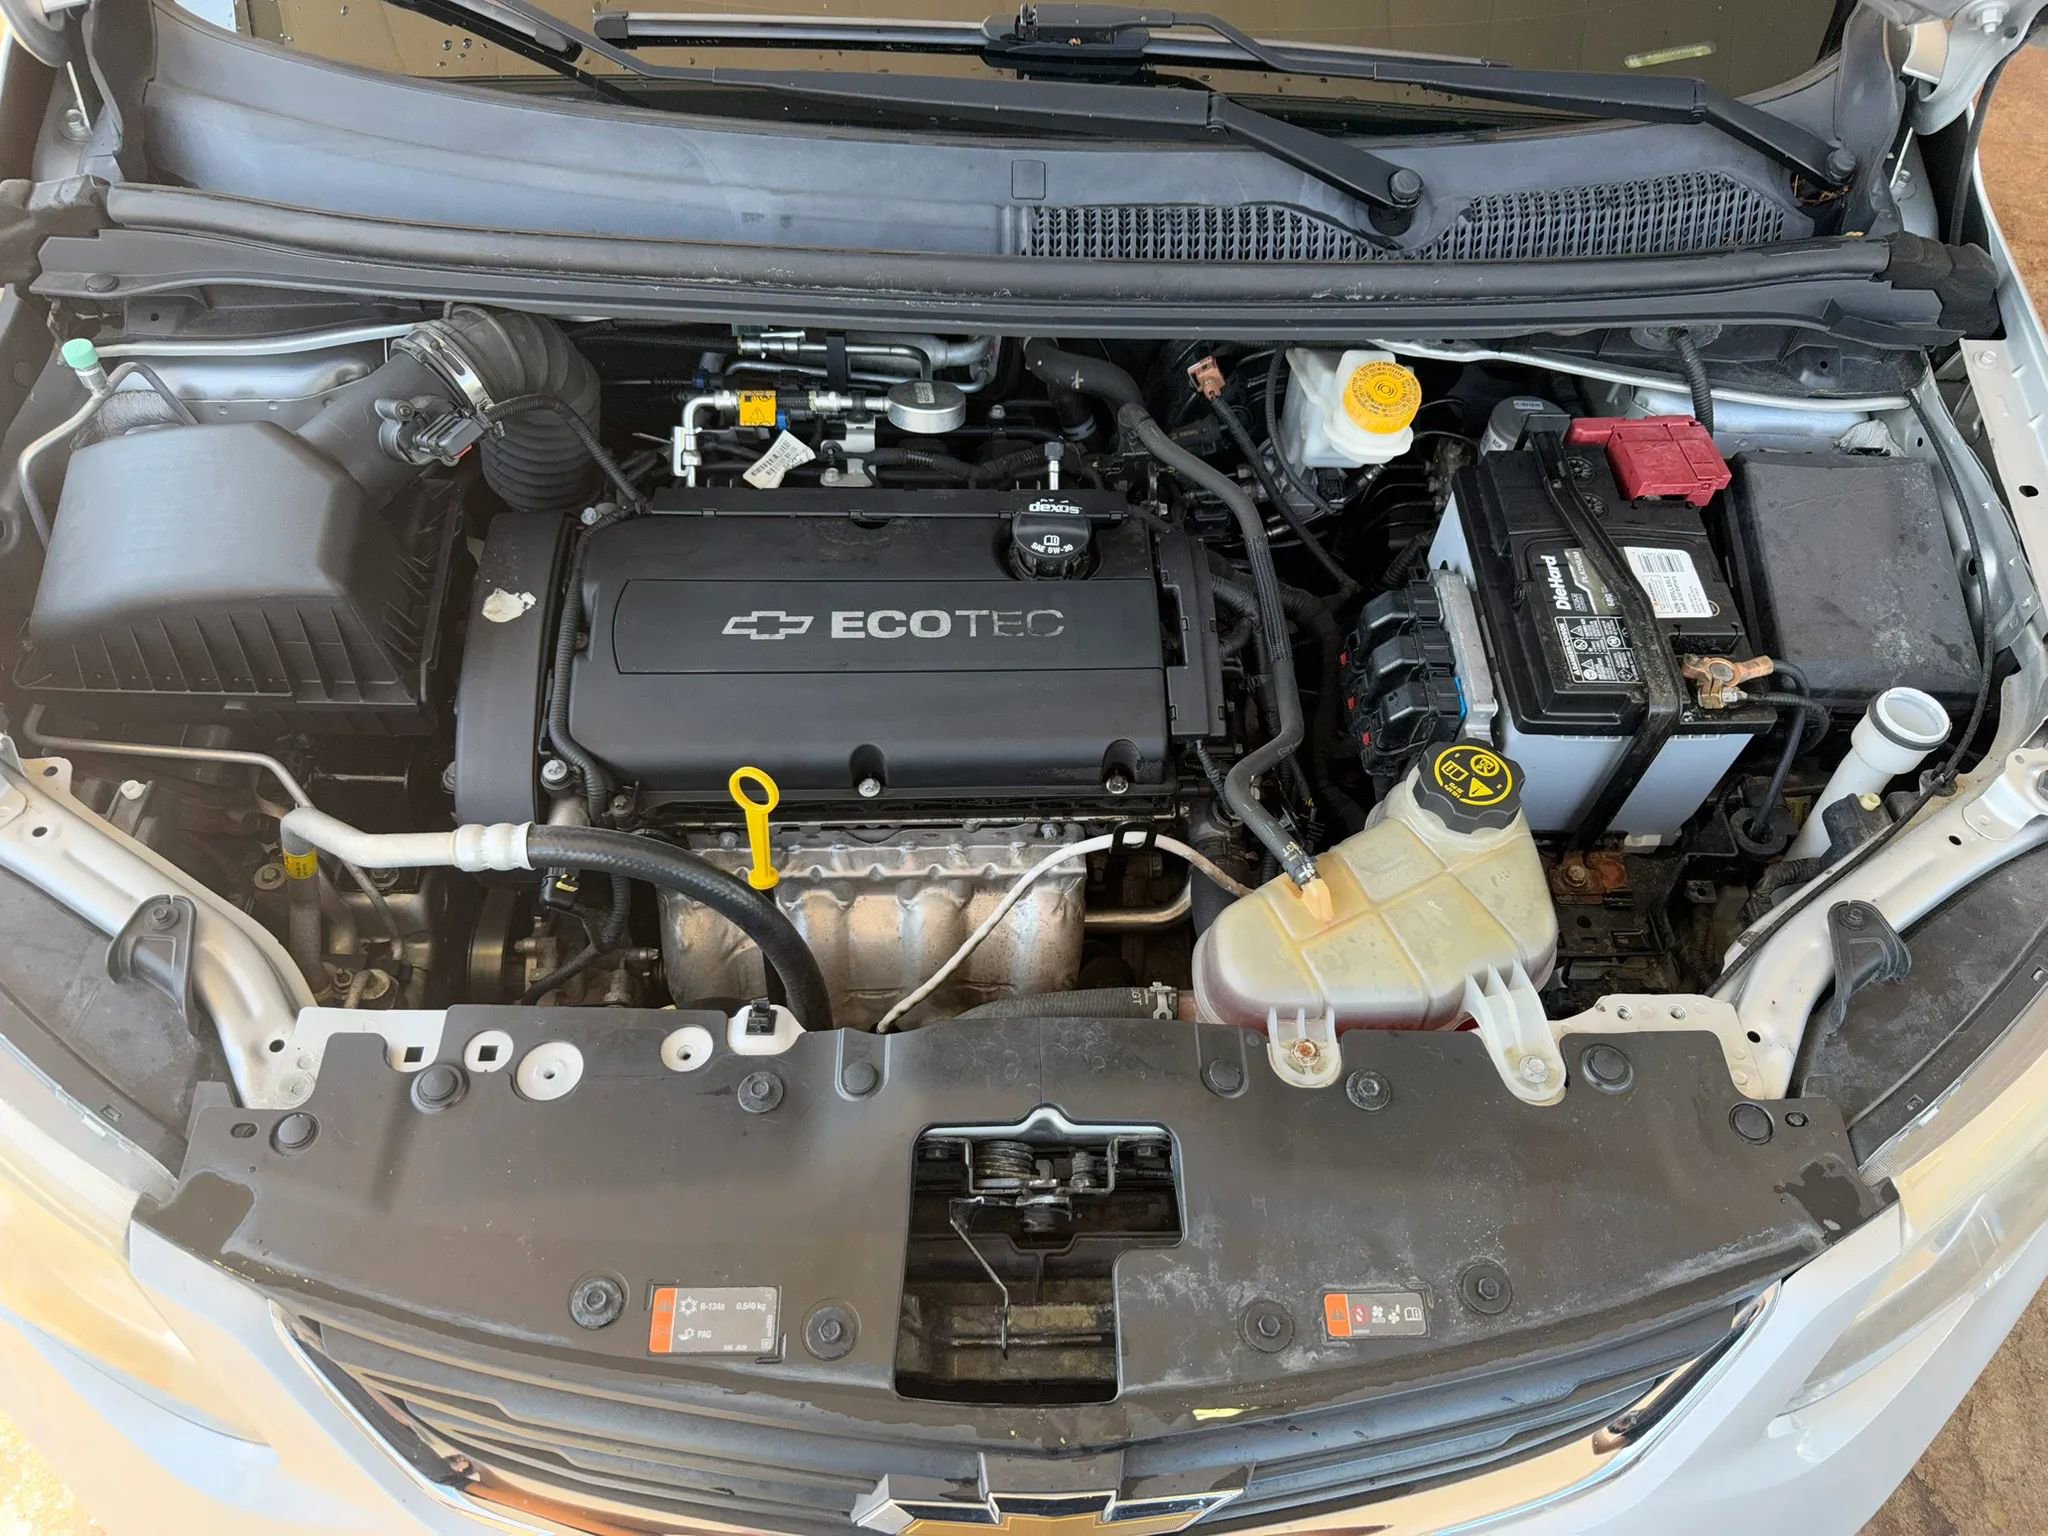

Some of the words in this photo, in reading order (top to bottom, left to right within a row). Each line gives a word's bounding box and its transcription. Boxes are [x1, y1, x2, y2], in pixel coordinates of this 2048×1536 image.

[1029, 502, 1080, 514] dexos
[1031, 542, 1046, 553] SAE
[1047, 544, 1074, 554] 5W-30
[1540, 555, 1572, 610] DieHard
[831, 609, 1065, 639] ECOTEC
[757, 1302, 767, 1312] kg
[697, 1329, 712, 1339] PAG
